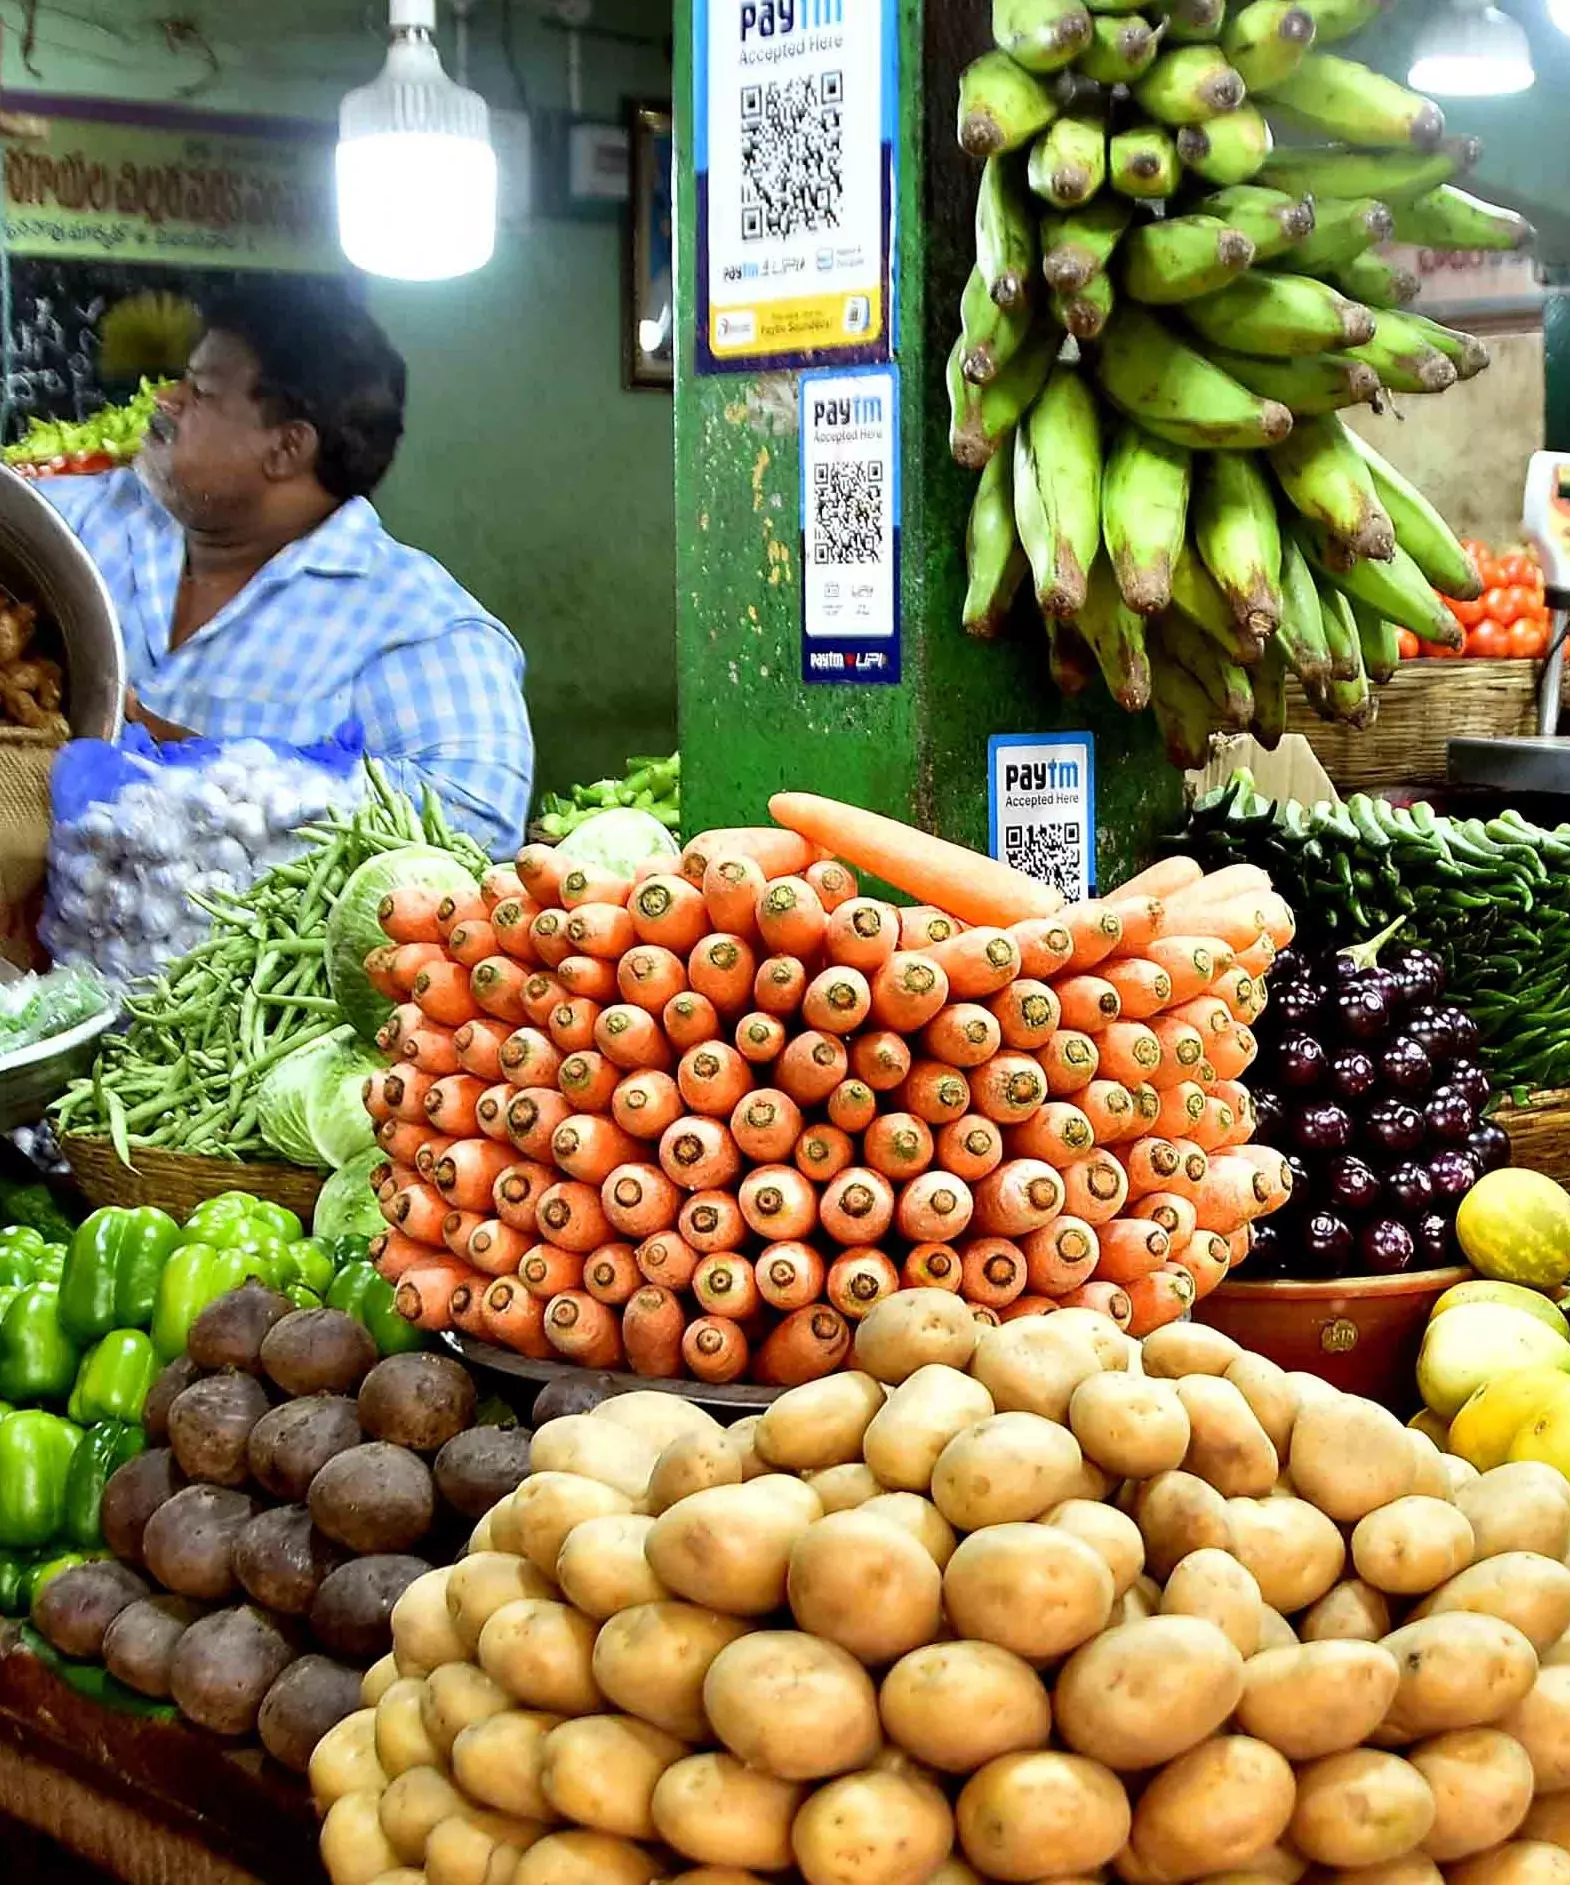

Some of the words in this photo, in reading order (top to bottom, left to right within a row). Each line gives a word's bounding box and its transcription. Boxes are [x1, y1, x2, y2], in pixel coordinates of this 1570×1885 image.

[739, 39, 805, 65] Accepted
[808, 35, 843, 53] Here
[1005, 793, 1053, 808] Accepted
[1056, 792, 1079, 805] Here
